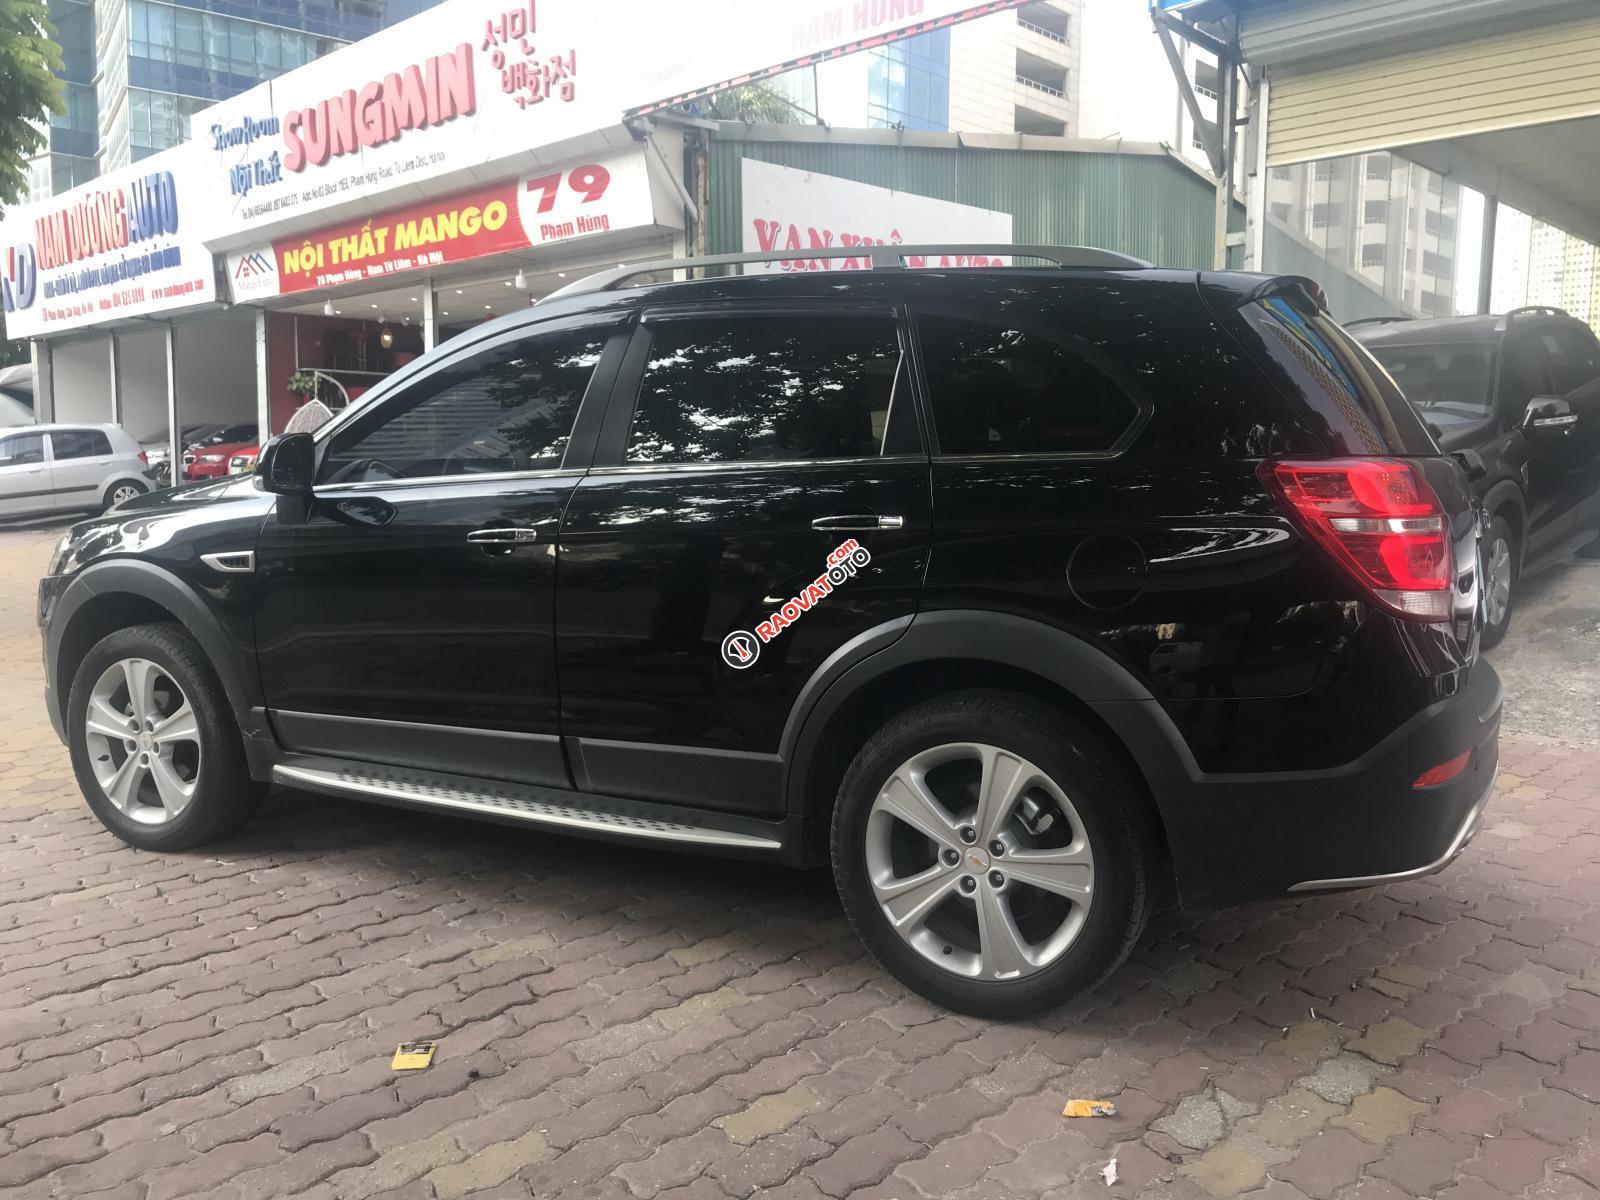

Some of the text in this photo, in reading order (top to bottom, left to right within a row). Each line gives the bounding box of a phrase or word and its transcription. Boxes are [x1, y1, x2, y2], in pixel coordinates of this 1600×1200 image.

[482, 0, 536, 70] 성민
[283, 42, 476, 173] SUNGMIN
[502, 49, 576, 110] 백화점
[35, 208, 73, 270] NAM
[127, 171, 179, 243] AUTO
[526, 164, 610, 214] 79
[283, 200, 508, 277] NỘI THẤT MANGO
